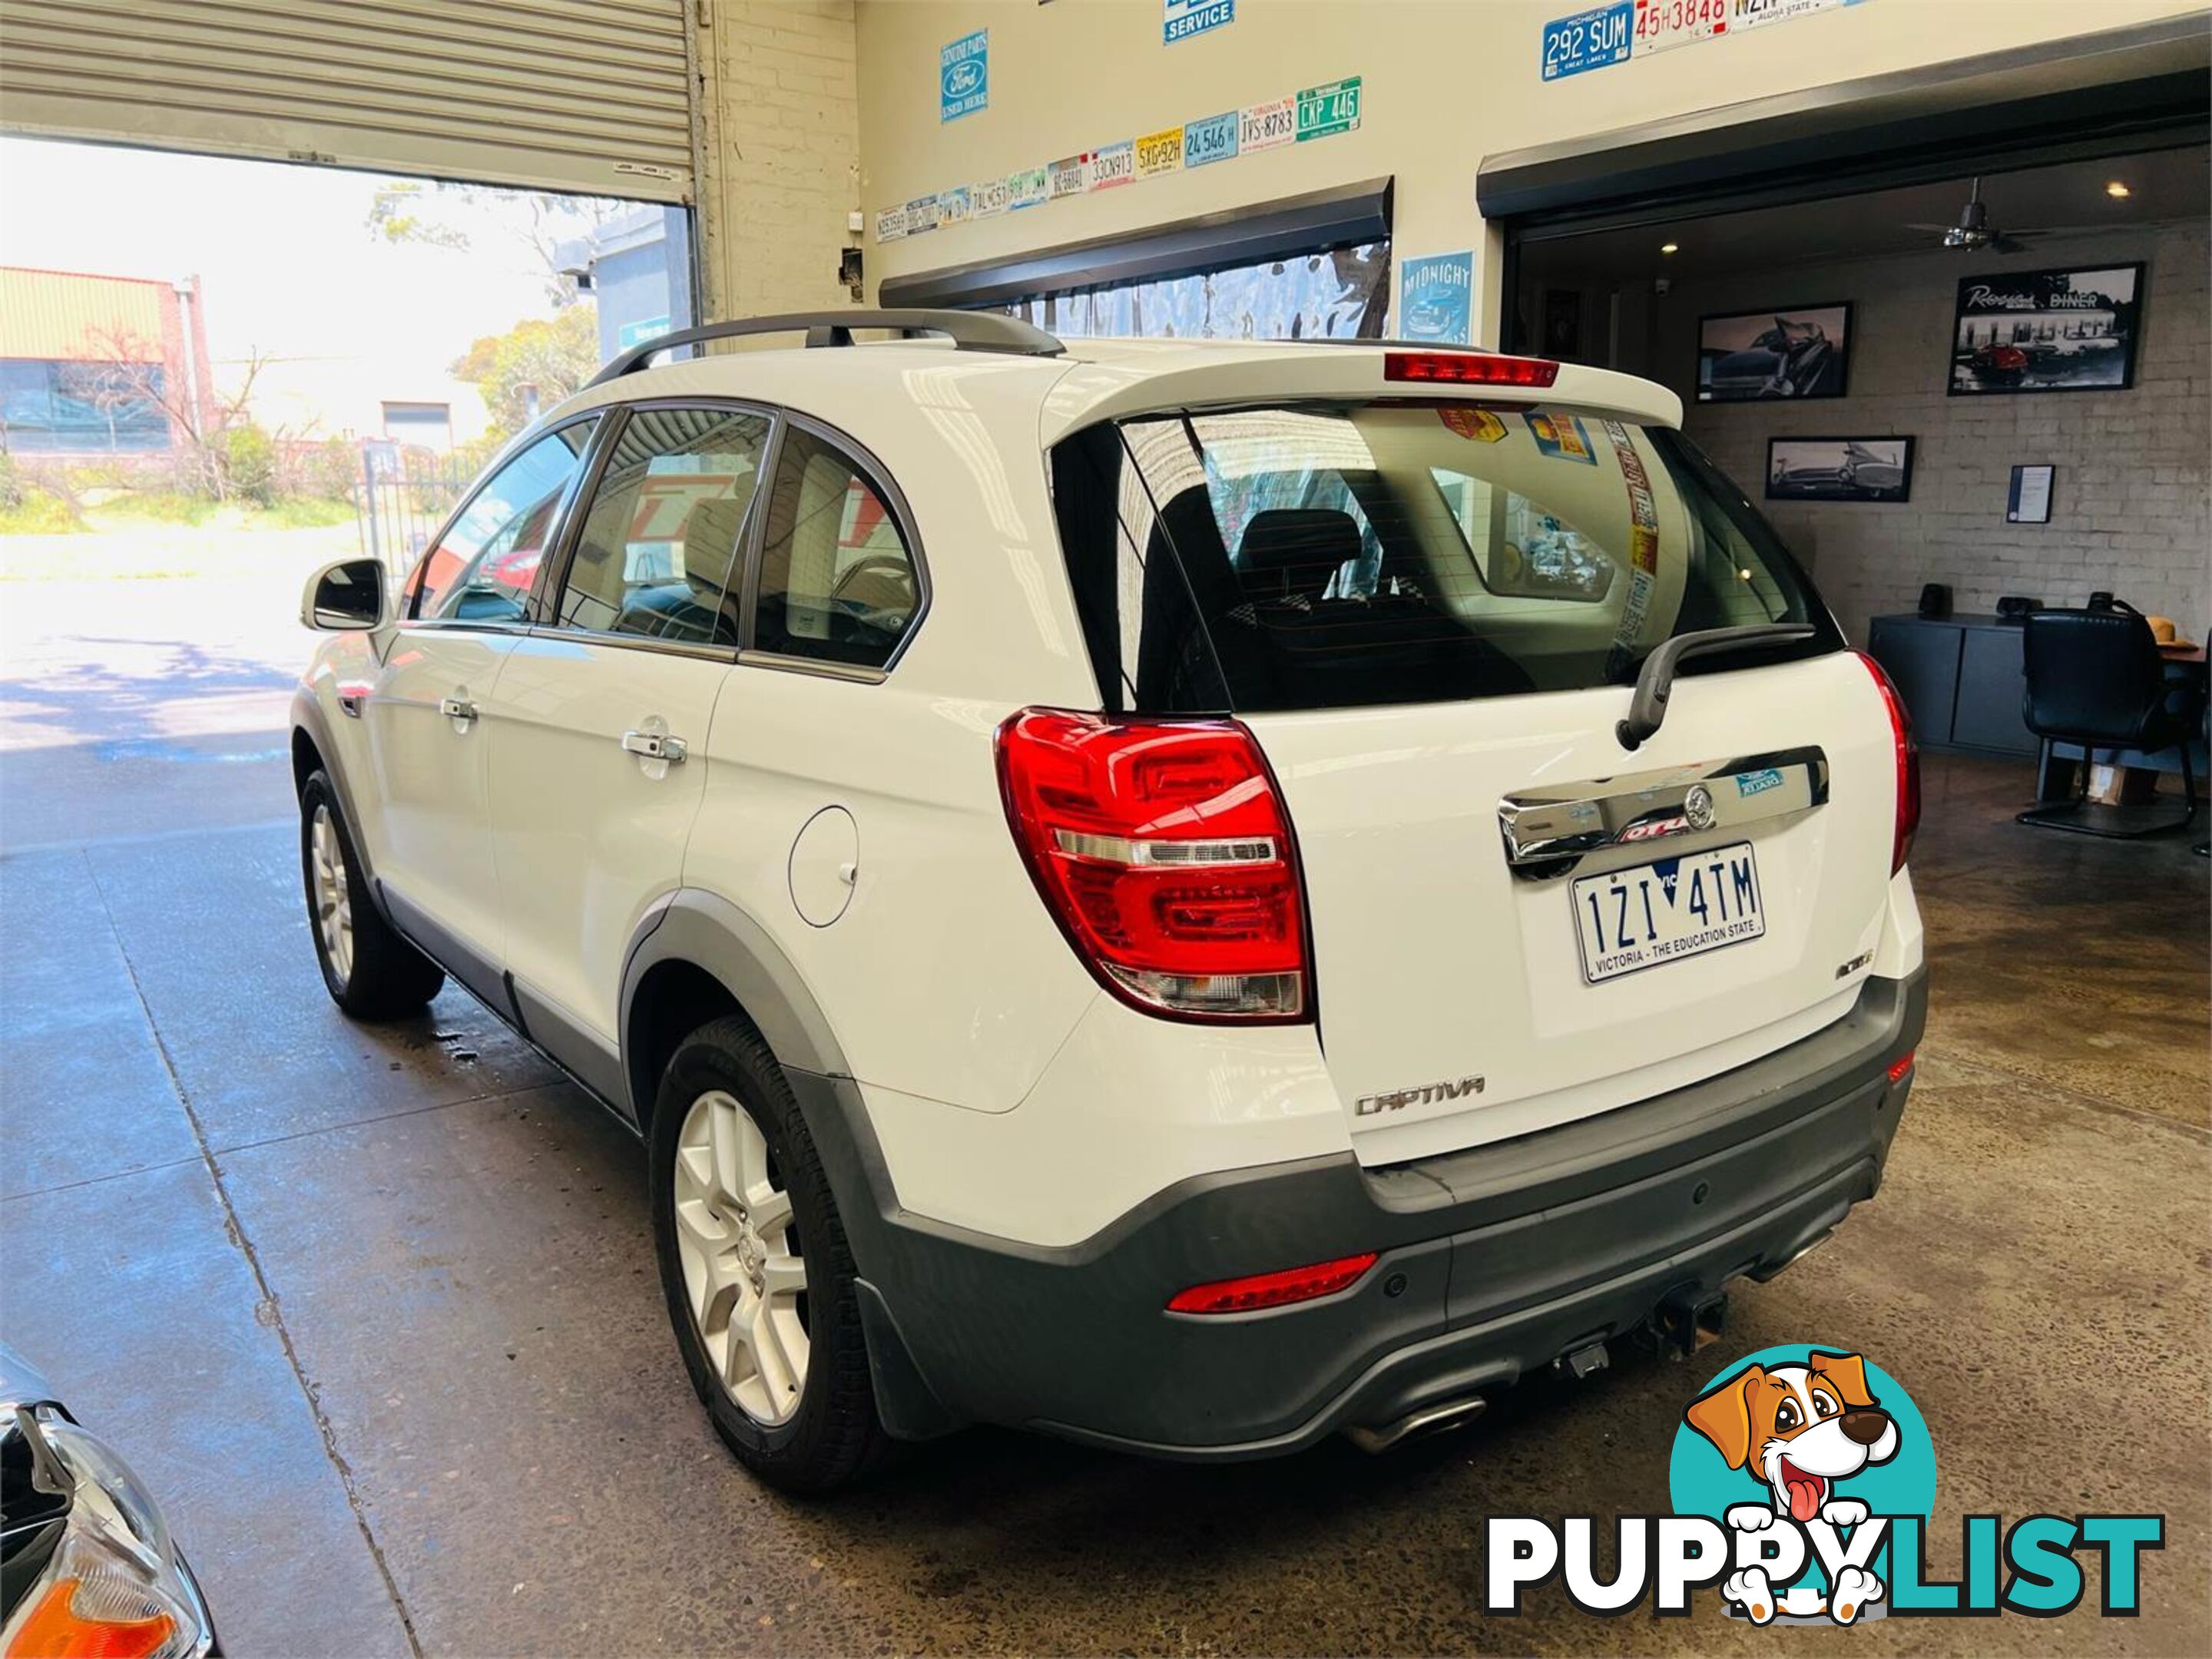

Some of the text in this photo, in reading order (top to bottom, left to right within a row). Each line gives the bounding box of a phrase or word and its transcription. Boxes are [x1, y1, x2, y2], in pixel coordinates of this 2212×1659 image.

[1169, 3, 1230, 38] SERVICE
[1567, 11, 1608, 27] MICHIGAN
[1757, 3, 1810, 21] ALOHA STATE
[1547, 13, 1627, 64] 292 SUM
[951, 65, 977, 91] Ford
[1565, 59, 1584, 69] GREAT
[1301, 91, 1355, 127] CKP 446
[1093, 153, 1132, 181] 33CN913
[1404, 263, 1470, 298] MIDNIGHT
[2049, 293, 2098, 308] DINER
[1661, 874, 1677, 888] VIC
[1588, 857, 1757, 954] 1ZI 4TM
[1595, 950, 1644, 974] VICTORIA
[1652, 942, 1671, 959] THE
[1674, 927, 1727, 952] EDUCATION
[1727, 919, 1755, 938] STATE
[1354, 1074, 1485, 1117] CAPTIVA
